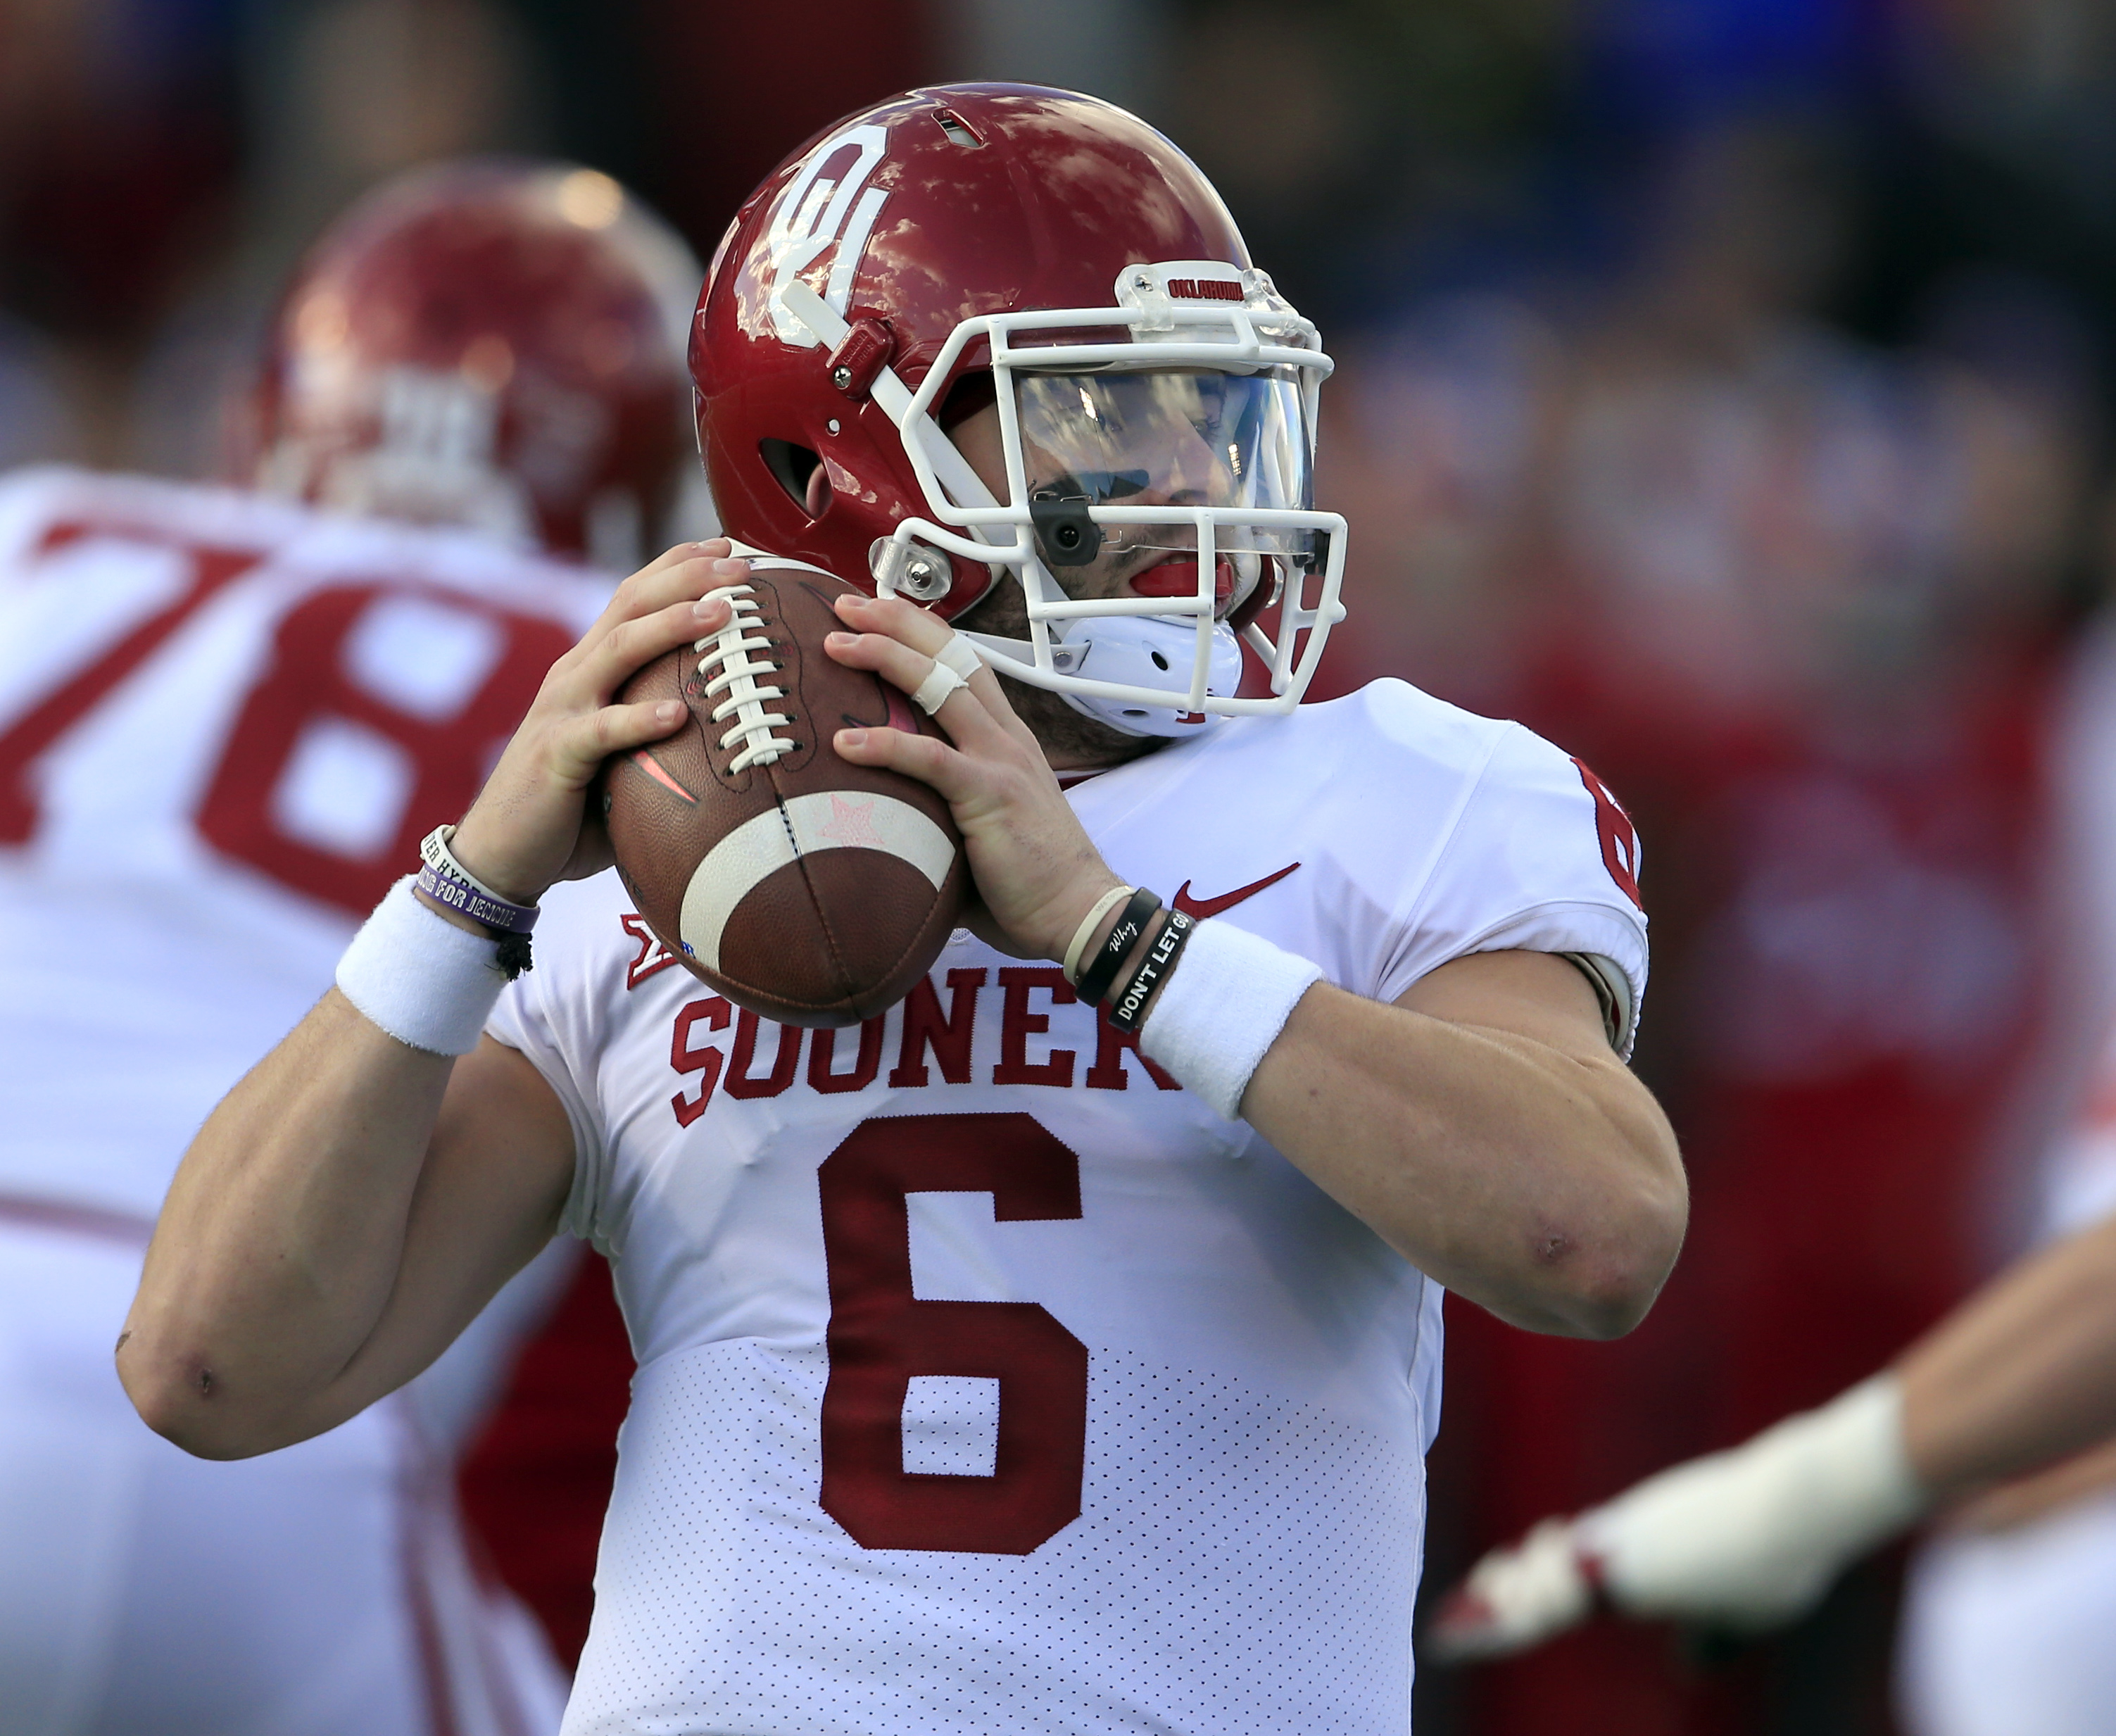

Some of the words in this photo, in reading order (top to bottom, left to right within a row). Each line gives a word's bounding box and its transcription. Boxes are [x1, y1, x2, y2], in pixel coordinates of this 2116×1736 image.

[1167, 279, 1245, 301] OKLAHOMA
[0, 518, 586, 931] 78
[434, 879, 467, 909] FOR
[465, 895, 516, 927] JENNIE
[436, 859, 481, 894] HYP
[1118, 963, 1157, 1021] DON'T
[1152, 926, 1180, 964] LET
[1172, 912, 1190, 930] GO
[817, 1112, 1090, 1556] 6
